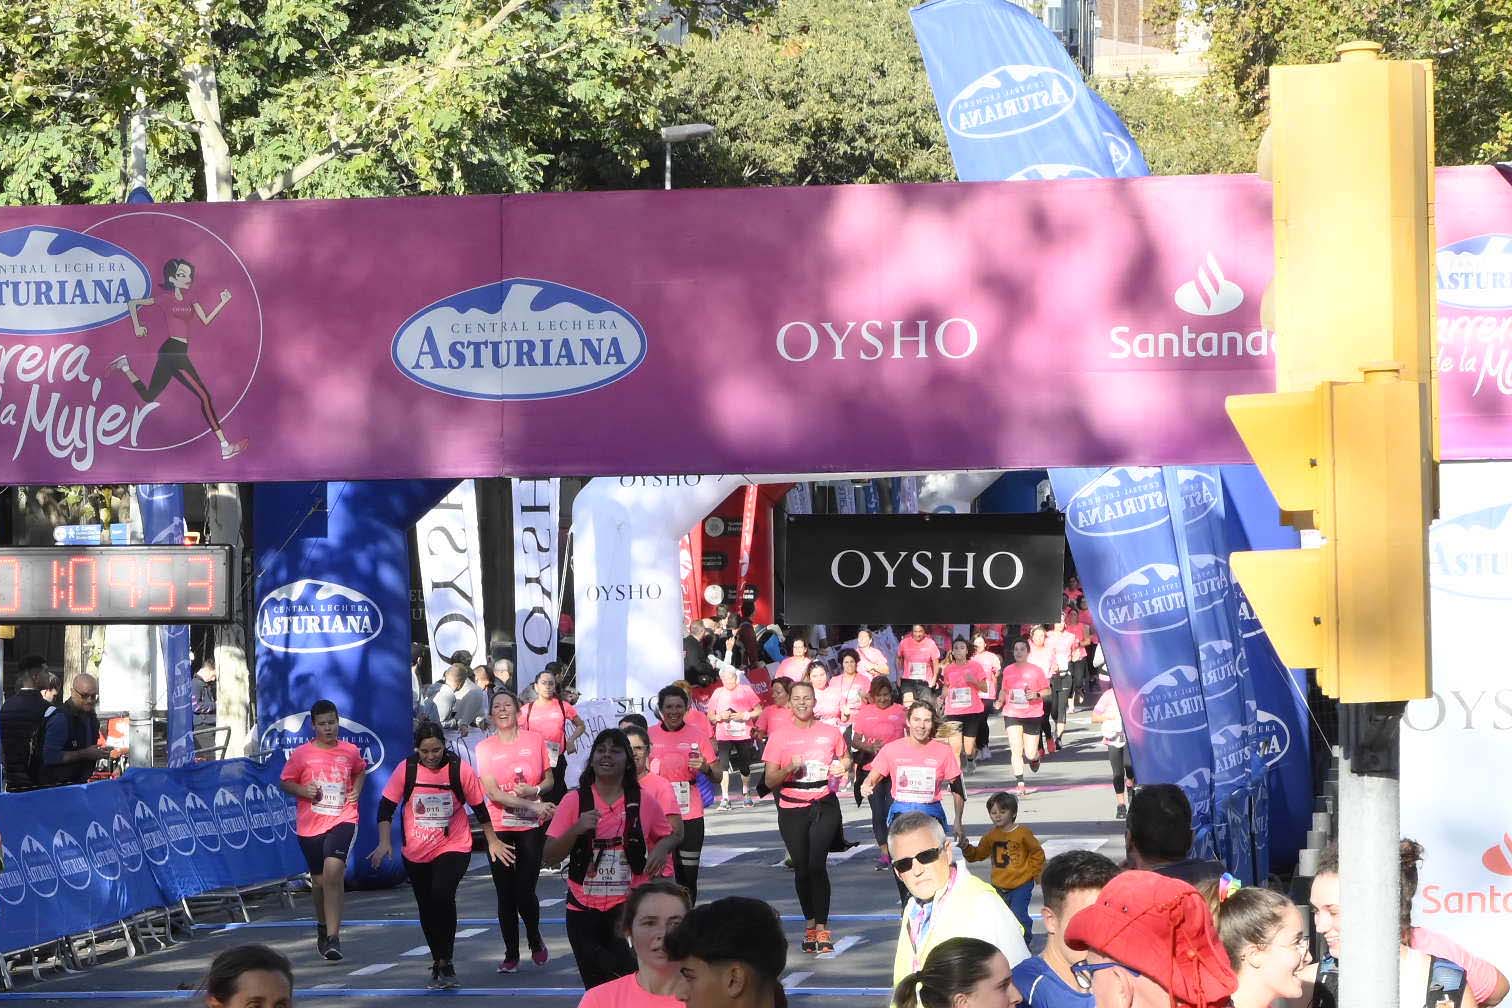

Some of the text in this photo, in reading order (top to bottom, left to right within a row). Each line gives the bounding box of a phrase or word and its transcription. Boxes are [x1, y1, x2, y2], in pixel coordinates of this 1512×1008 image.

[54, 260, 126, 274] LECHERA
[451, 318, 618, 334] CENTRAL LECHERA
[775, 317, 979, 362] OYSHO
[411, 326, 626, 370] ASTURIANA
[13, 378, 161, 472] Mujer
[830, 547, 1025, 590] OYSHO
[585, 583, 662, 602] OYSHO
[261, 608, 374, 637] ASTURIANA
[273, 604, 369, 614] CENTRAL LECHERA
